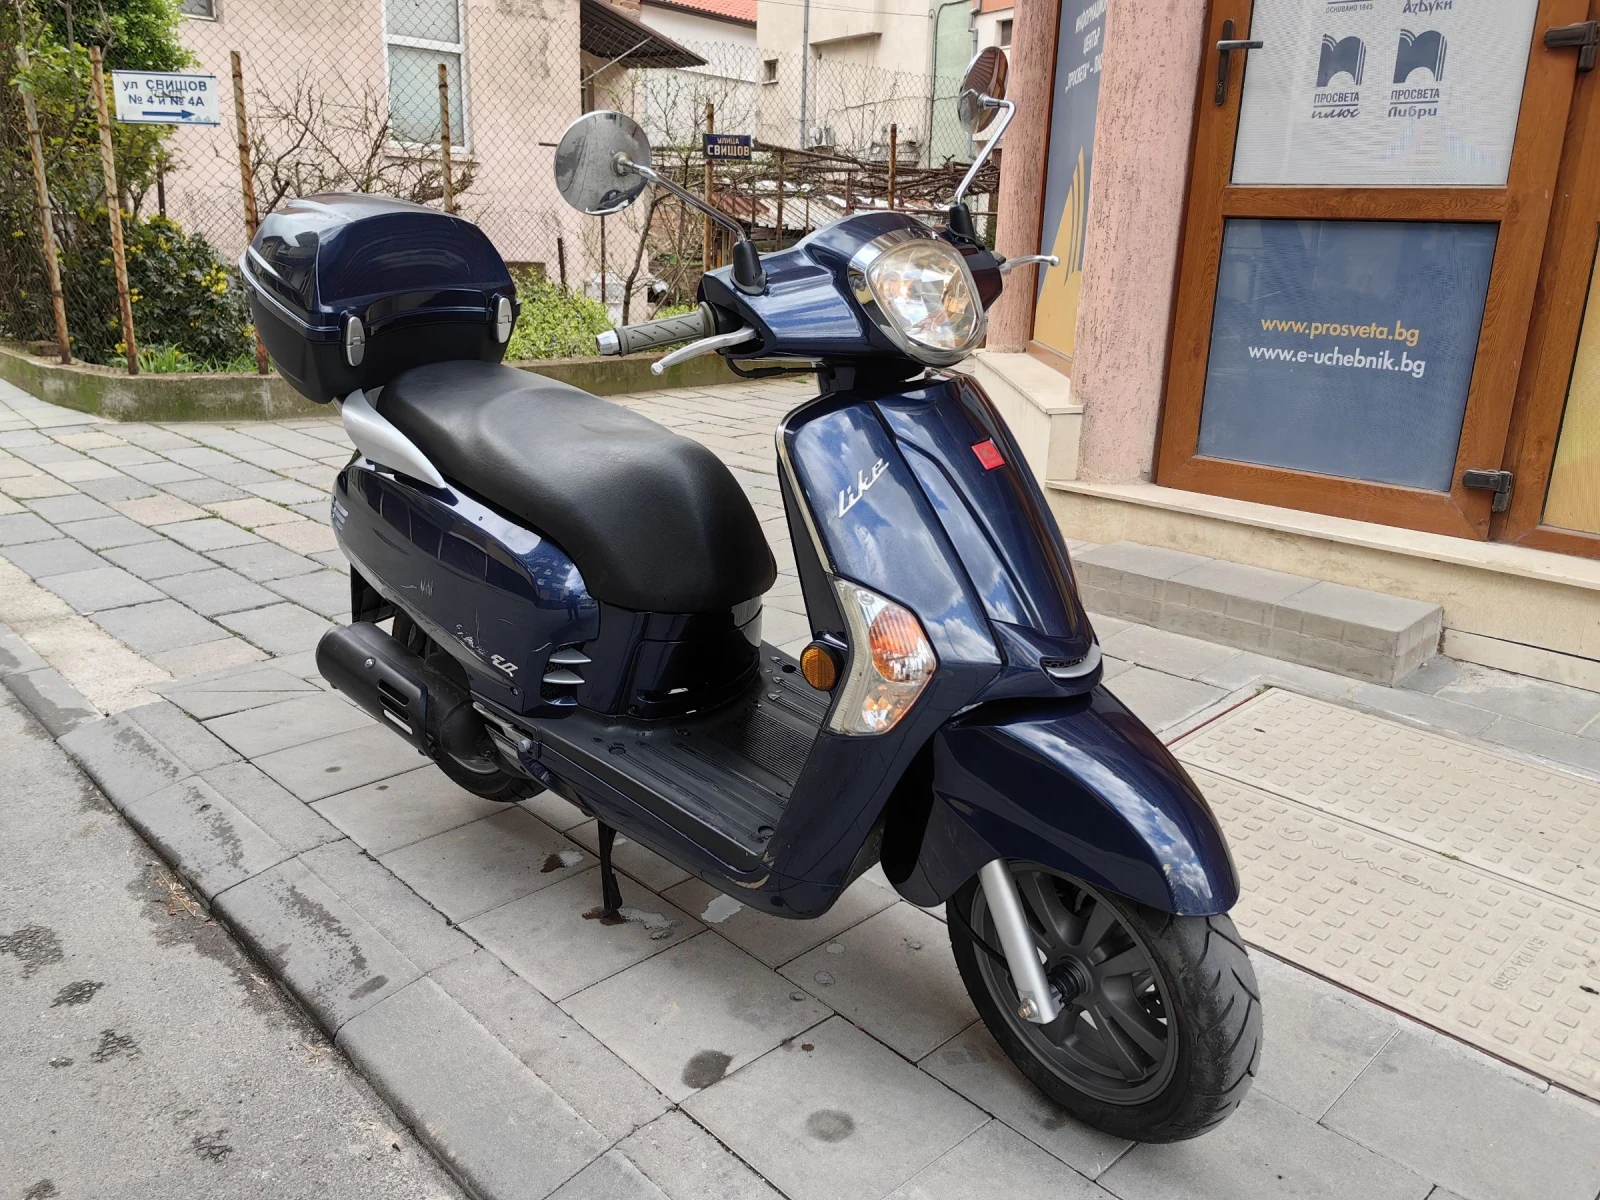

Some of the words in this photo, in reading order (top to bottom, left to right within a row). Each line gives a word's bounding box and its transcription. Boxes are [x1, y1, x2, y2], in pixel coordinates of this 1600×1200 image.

[1325, 4, 1358, 13] ОСНОВАНО
[1359, 3, 1373, 11] 1945
[122, 81, 138, 91] ул
[145, 79, 207, 92] СВИЩОВ
[1313, 92, 1360, 103] ПРОСВЕТА
[1390, 88, 1440, 100] ПРОСВЕТА
[147, 96, 154, 105] 4
[1311, 108, 1361, 119] плюс
[707, 145, 750, 156] СВИЩОВ
[1261, 318, 1420, 347] www.prosveta.bg
[1248, 346, 1426, 379] www.e-uchebnik.bg
[838, 458, 889, 519] Like
[1311, 839, 1456, 899] VIVACOM
